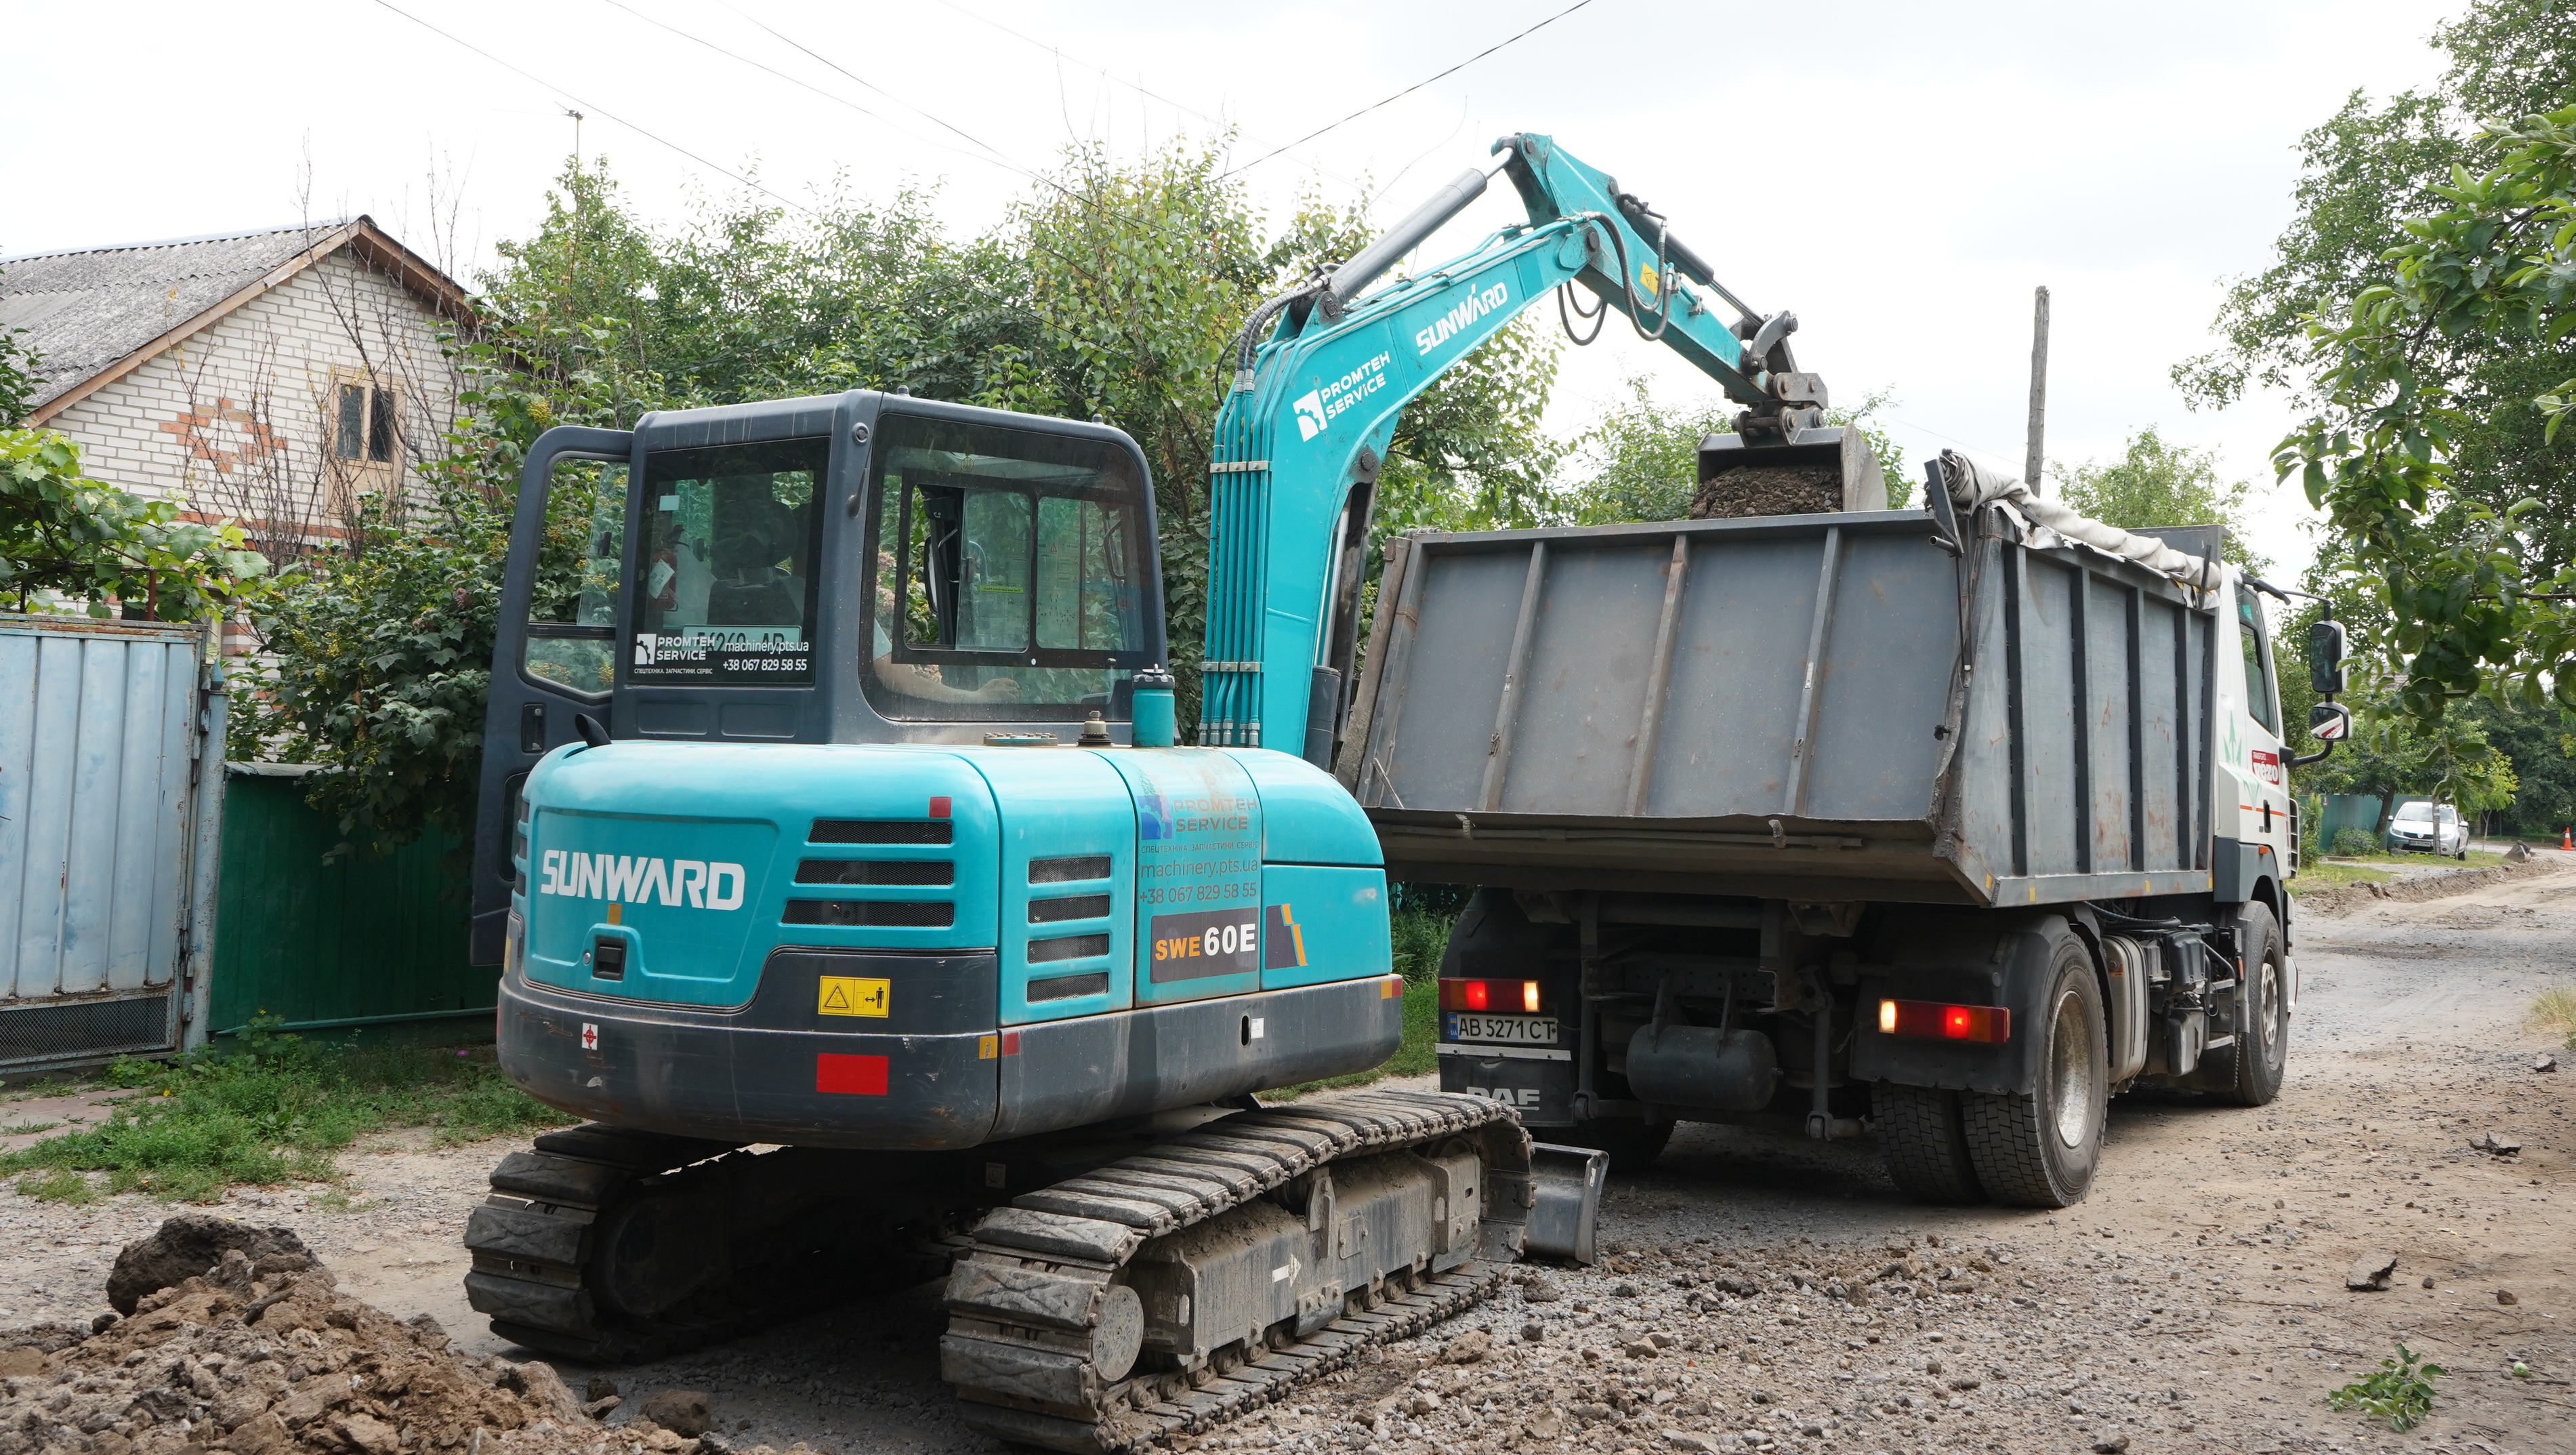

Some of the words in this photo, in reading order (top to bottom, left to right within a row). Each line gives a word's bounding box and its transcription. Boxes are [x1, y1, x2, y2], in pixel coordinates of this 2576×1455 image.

[1415, 282, 1508, 356] SUNWARD
[1321, 351, 1390, 403] PROMTEH
[1328, 372, 1386, 419] SERVICE
[658, 636, 715, 647] PROMTEH
[724, 640, 809, 655] machinery.pts.ua
[657, 650, 707, 661] SERVICE
[723, 659, 740, 671] +38
[742, 659, 760, 670] 067
[762, 659, 779, 670] 829
[781, 659, 795, 670] 58
[795, 659, 808, 670] 55
[1173, 798, 1258, 813] PROMTEH
[1176, 815, 1248, 832] SERVICE
[1237, 841, 1258, 849] СЕРВІС
[1141, 857, 1258, 879] machinery.pts.ua
[541, 849, 745, 911] SUNWARD
[1140, 888, 1164, 905] +38
[1168, 885, 1193, 903] 067
[1197, 884, 1220, 901] 829
[1224, 883, 1239, 899] 58
[1242, 882, 1257, 898] 55
[1459, 1018, 1481, 1037] AB
[1487, 1019, 1524, 1038] 5271
[1529, 1021, 1555, 1040] CT
